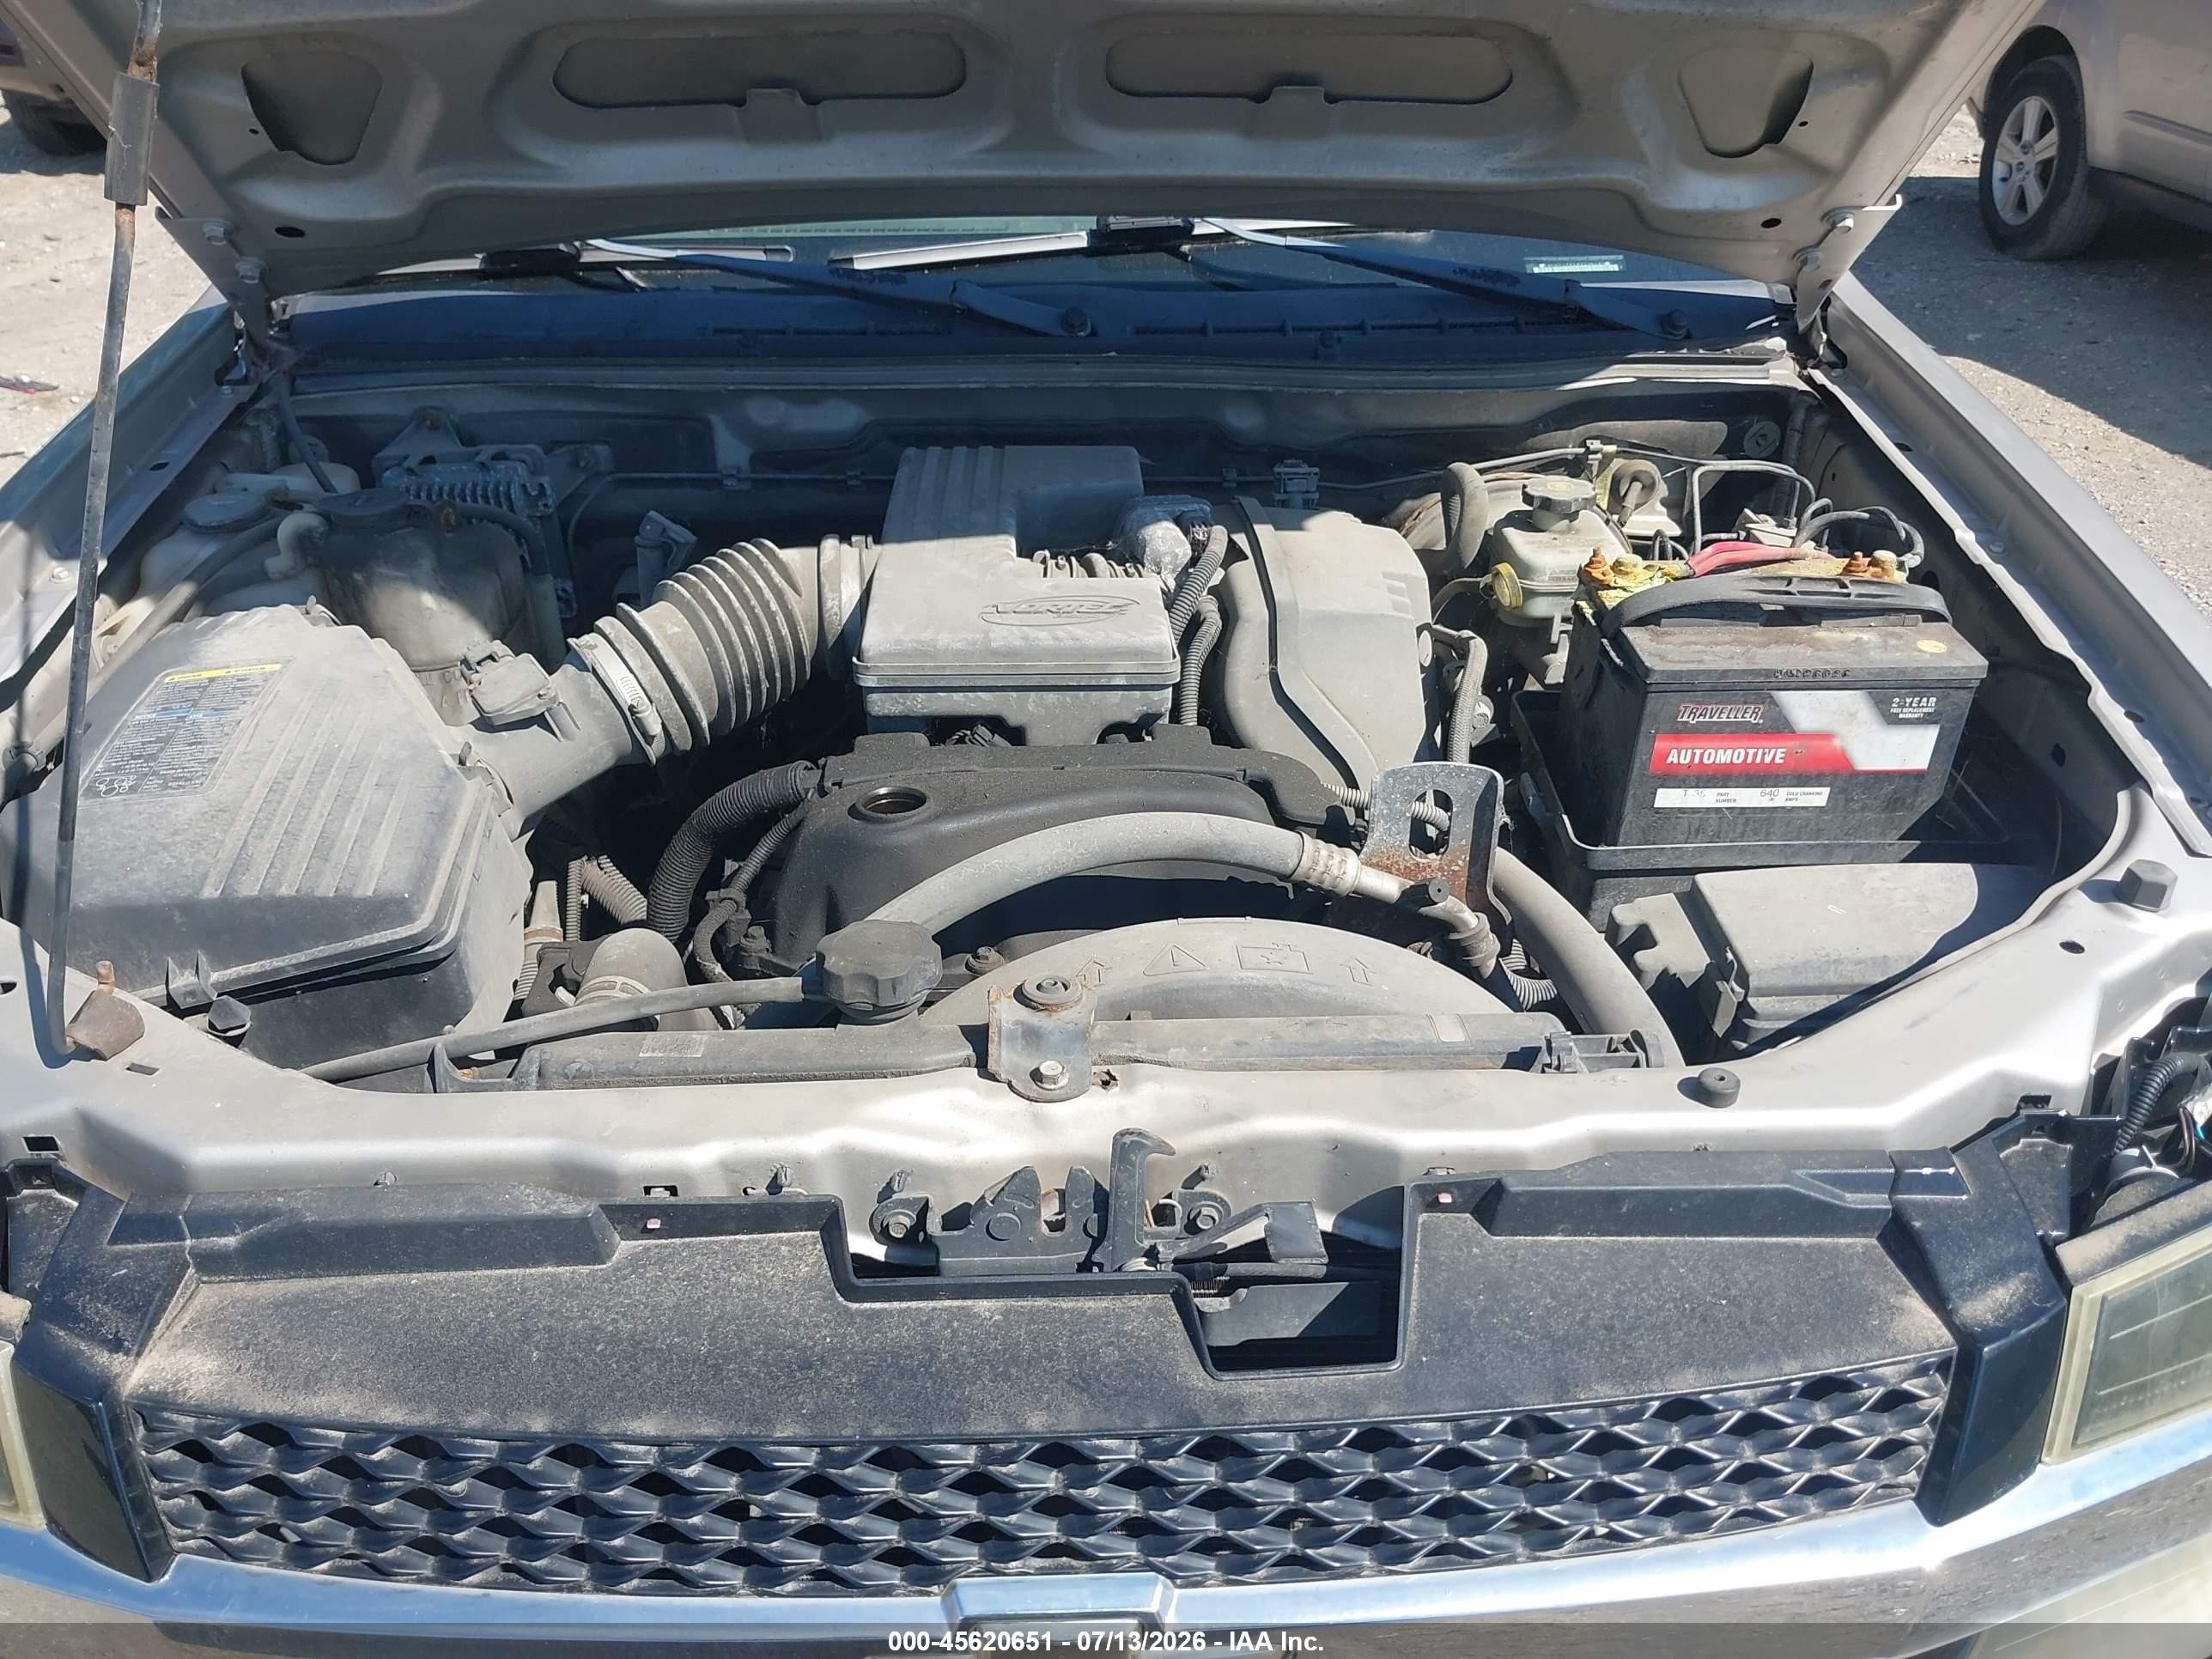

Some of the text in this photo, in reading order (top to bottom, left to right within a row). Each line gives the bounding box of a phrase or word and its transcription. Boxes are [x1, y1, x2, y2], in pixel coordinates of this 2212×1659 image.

[1891, 696, 1937, 708] 2-YEAR
[1676, 704, 1763, 724] TRAVELLER
[1666, 748, 1787, 764] AUTOMOTIVE
[1759, 788, 1780, 798] 640
